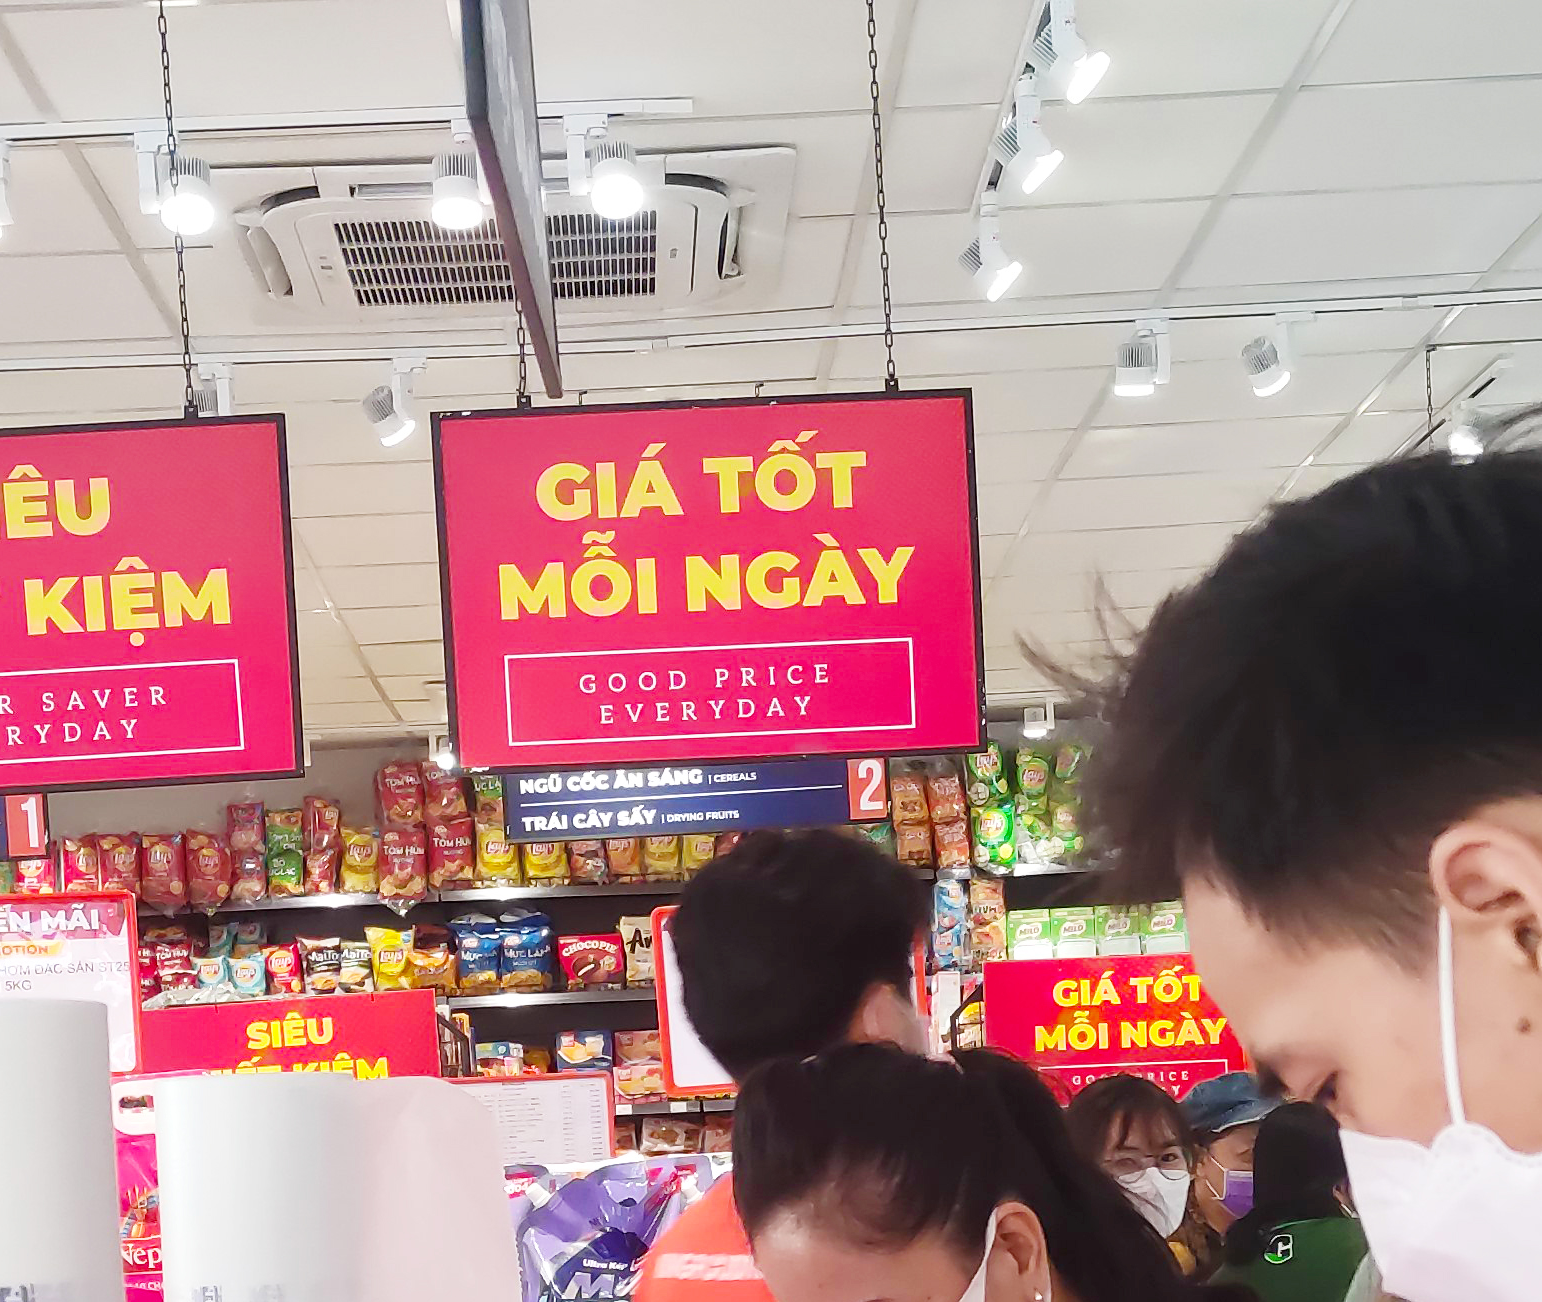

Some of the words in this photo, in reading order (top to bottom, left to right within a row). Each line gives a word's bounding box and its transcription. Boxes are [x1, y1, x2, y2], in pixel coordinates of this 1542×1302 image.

[536, 442, 684, 521] GIÁ
[703, 430, 868, 514] TỐT
[498, 531, 658, 621] MỖI
[686, 534, 915, 612] NGÀY
[24, 556, 232, 648] KIỆM
[579, 672, 688, 695] GOOD
[715, 664, 831, 690] PRICE
[43, 686, 168, 712] SAVER
[600, 695, 813, 725] EVERYDAY
[519, 771, 561, 795] NGŨ
[565, 768, 611, 793] CỐC
[613, 767, 645, 789] ĂN
[646, 766, 704, 787] SÁNG
[714, 771, 757, 784] CEREALS
[857, 763, 883, 811] 2
[21, 799, 41, 850] 1
[521, 807, 568, 832] TRÁI
[569, 807, 611, 829] CÂY
[614, 802, 656, 827] SẤY
[666, 812, 705, 824] DRYING
[707, 809, 740, 822] FRUITS
[41, 903, 100, 932] MÃI
[5, 980, 33, 992] 5KG
[1052, 971, 1121, 1008] GIÁ
[1129, 965, 1203, 1005] TỐT
[246, 1011, 333, 1049] SIÊU
[1034, 1010, 1109, 1053] MỖI
[1120, 1012, 1228, 1048] NGÀY
